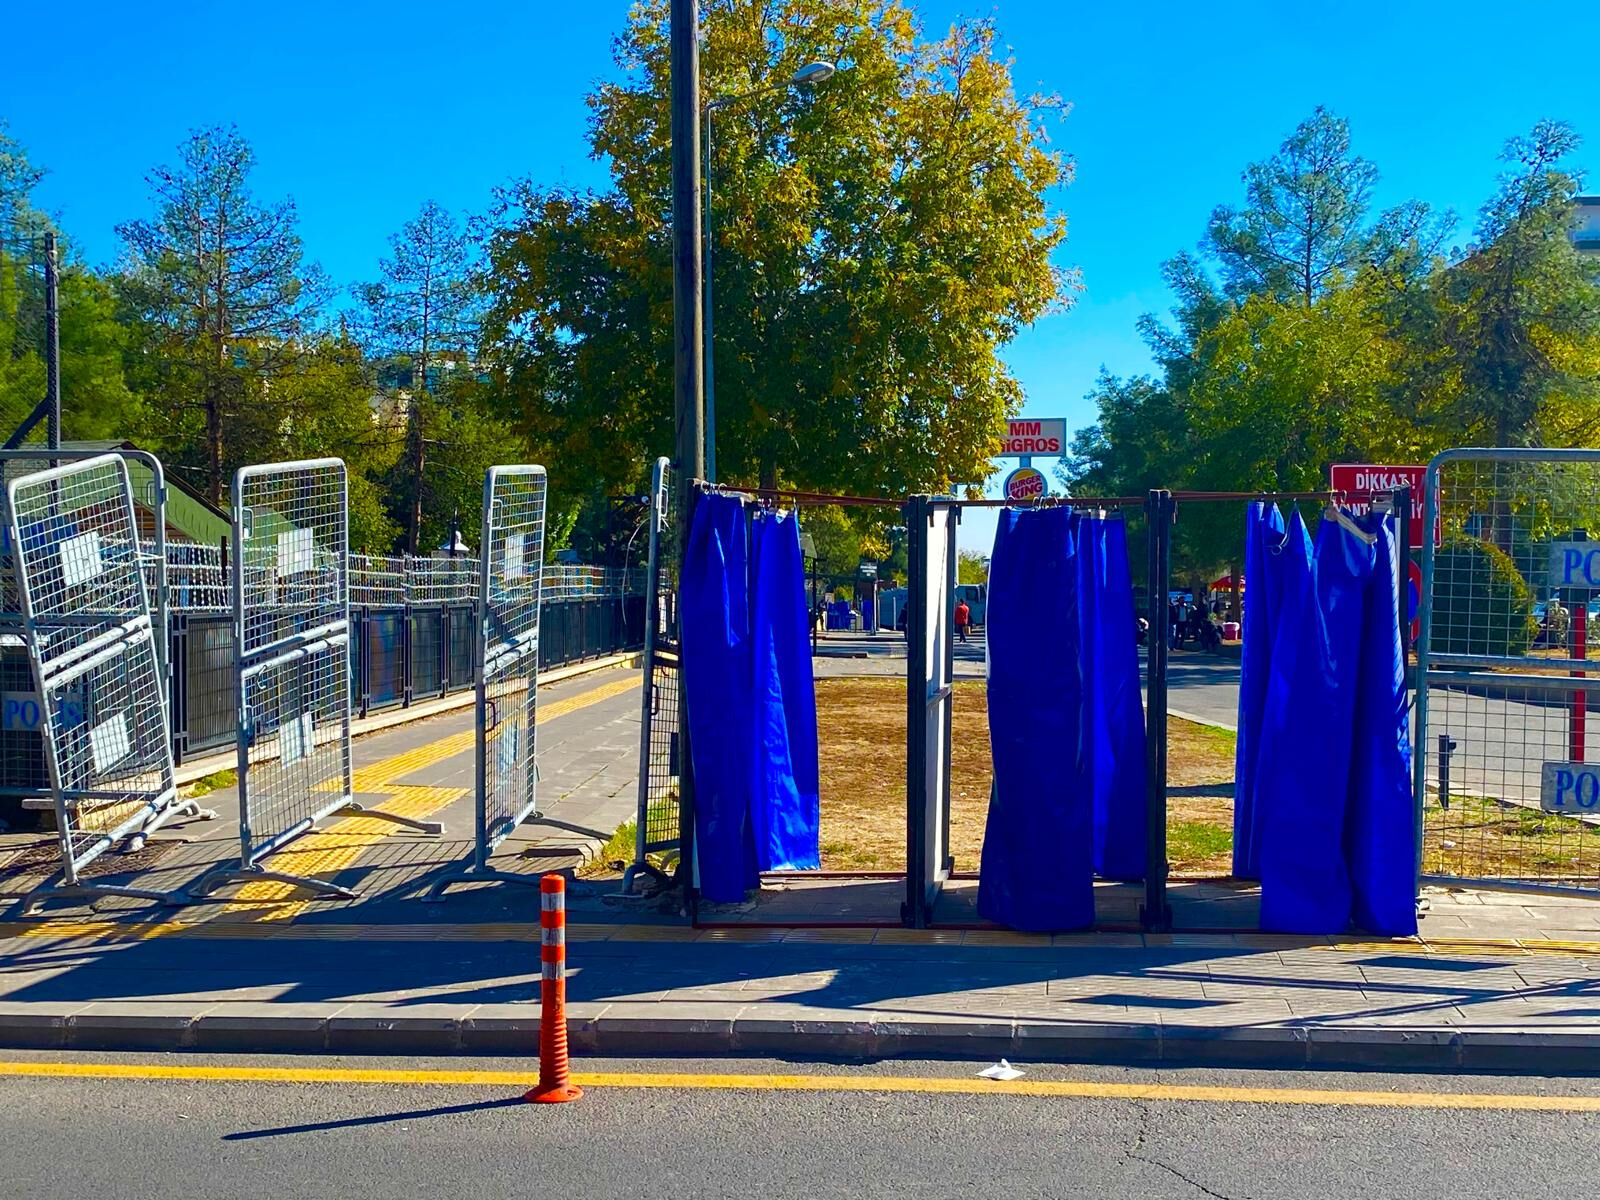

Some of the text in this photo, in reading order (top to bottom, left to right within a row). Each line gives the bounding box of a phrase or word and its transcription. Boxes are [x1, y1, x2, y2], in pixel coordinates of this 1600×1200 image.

[1010, 422, 1041, 436] MM
[1010, 474, 1042, 491] BURGER
[1011, 482, 1043, 499] KING
